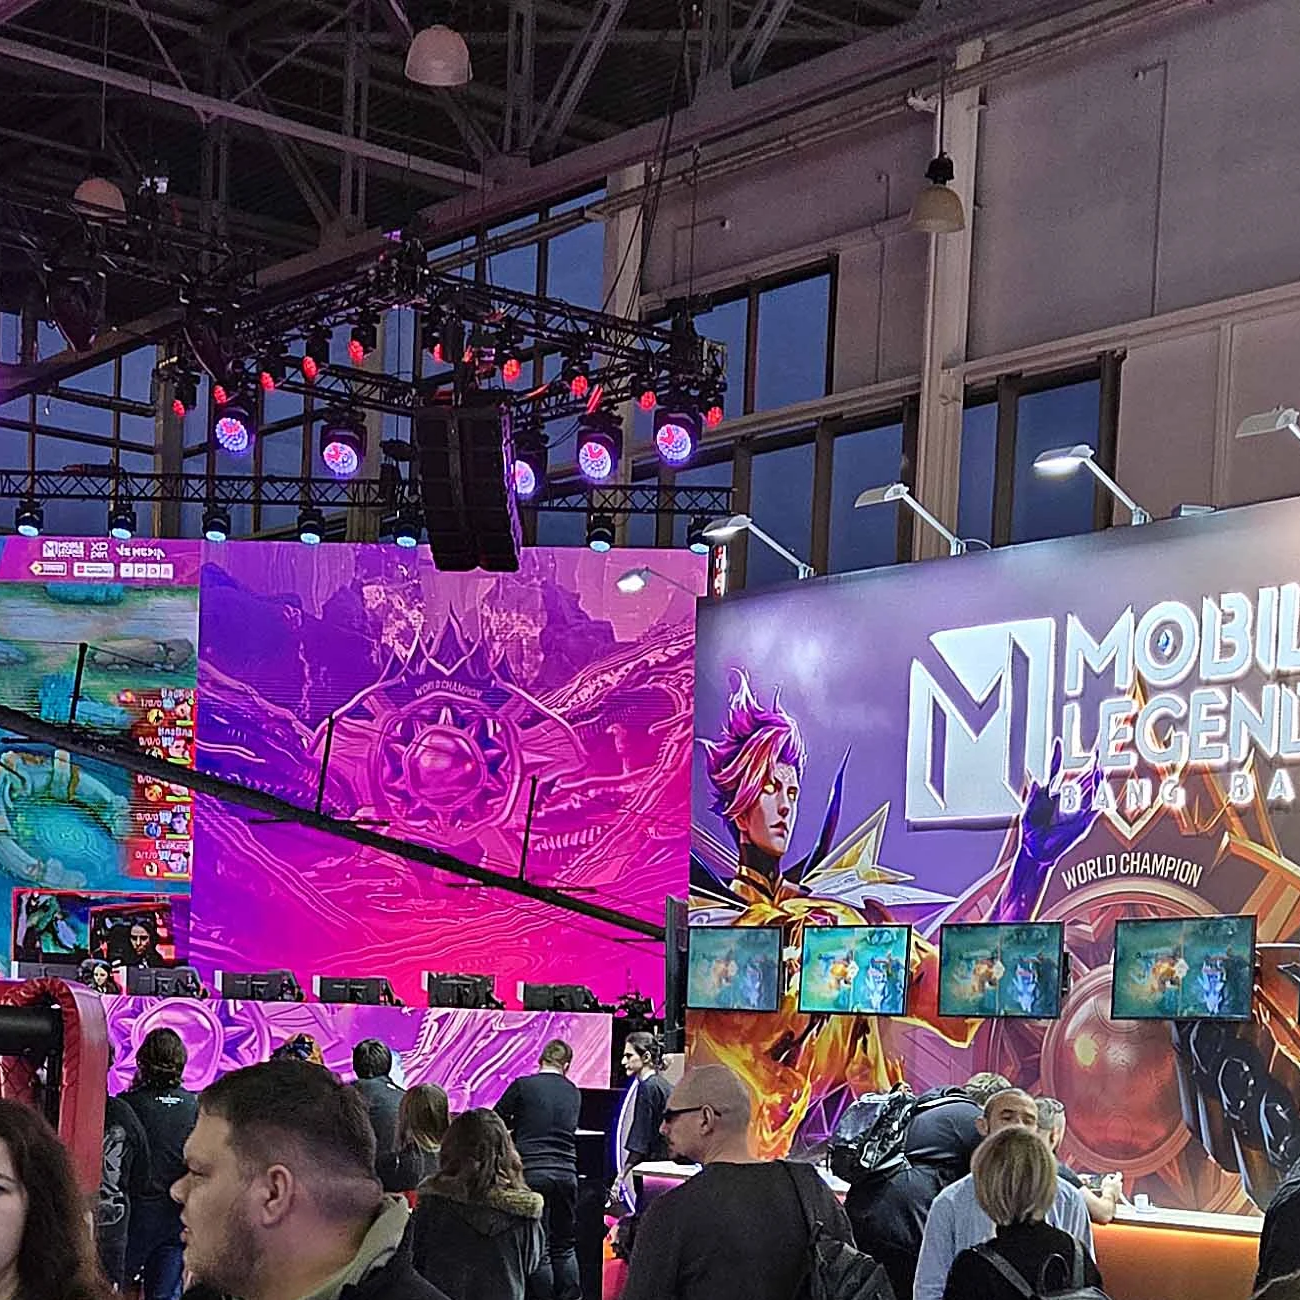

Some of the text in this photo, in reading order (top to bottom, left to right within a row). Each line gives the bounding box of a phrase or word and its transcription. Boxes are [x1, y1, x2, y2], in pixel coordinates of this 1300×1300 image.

[1057, 778, 1187, 814] BANG
[1061, 852, 1203, 890] WORLD CHAMPION
